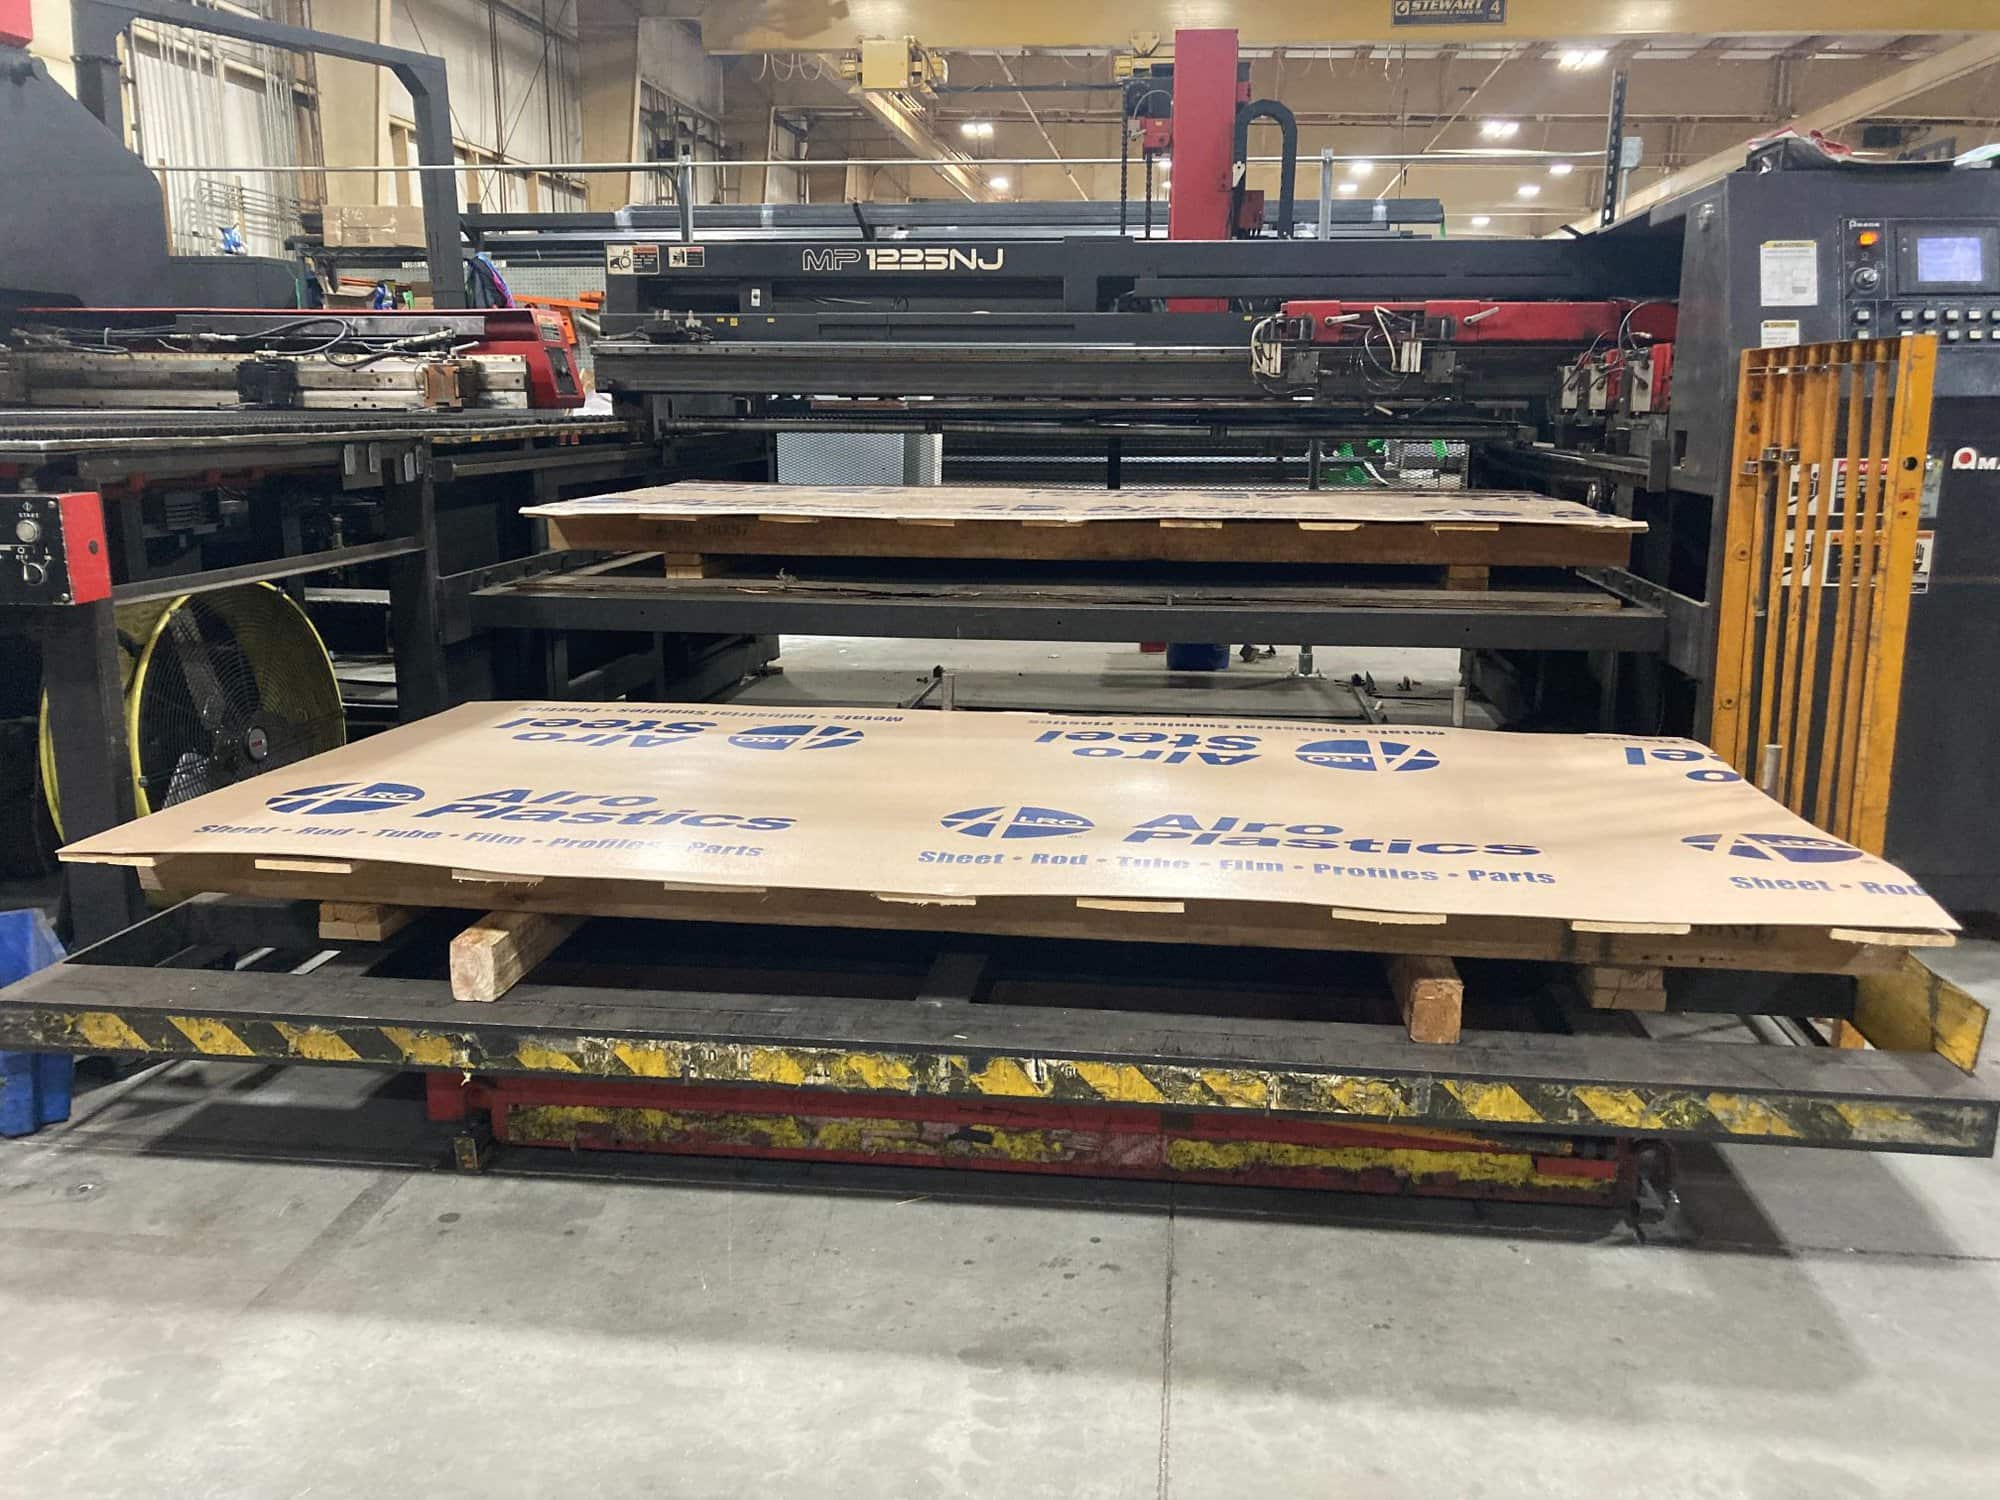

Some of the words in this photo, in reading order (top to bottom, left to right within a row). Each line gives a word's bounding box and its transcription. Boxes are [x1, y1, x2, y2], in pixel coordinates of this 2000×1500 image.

[1411, 0, 1484, 10] STEWART
[1490, 0, 1500, 13] 4
[803, 249, 861, 271] MP
[866, 248, 1004, 271] 1225NJ
[1952, 447, 2000, 470] AM
[493, 717, 718, 734] Steel
[512, 732, 697, 748] Alro
[1034, 730, 1263, 751] Steel
[1071, 747, 1262, 766] Alro
[457, 788, 659, 807] Alro
[411, 802, 798, 831] Plastics
[1131, 813, 1345, 836] Alro
[193, 823, 279, 834] Sheet
[296, 825, 354, 837] Rod
[373, 827, 443, 840] Tube
[463, 830, 527, 846] Film
[686, 841, 765, 857] Parts
[1121, 829, 1542, 855] Plastics
[918, 850, 1005, 865] Sheet
[1030, 852, 1089, 866] Rod
[1116, 855, 1191, 869] Tube
[1219, 858, 1285, 873] Film
[1313, 862, 1440, 881] Profiles
[1467, 869, 1557, 885] Parts
[1728, 875, 1836, 892] Sheet
